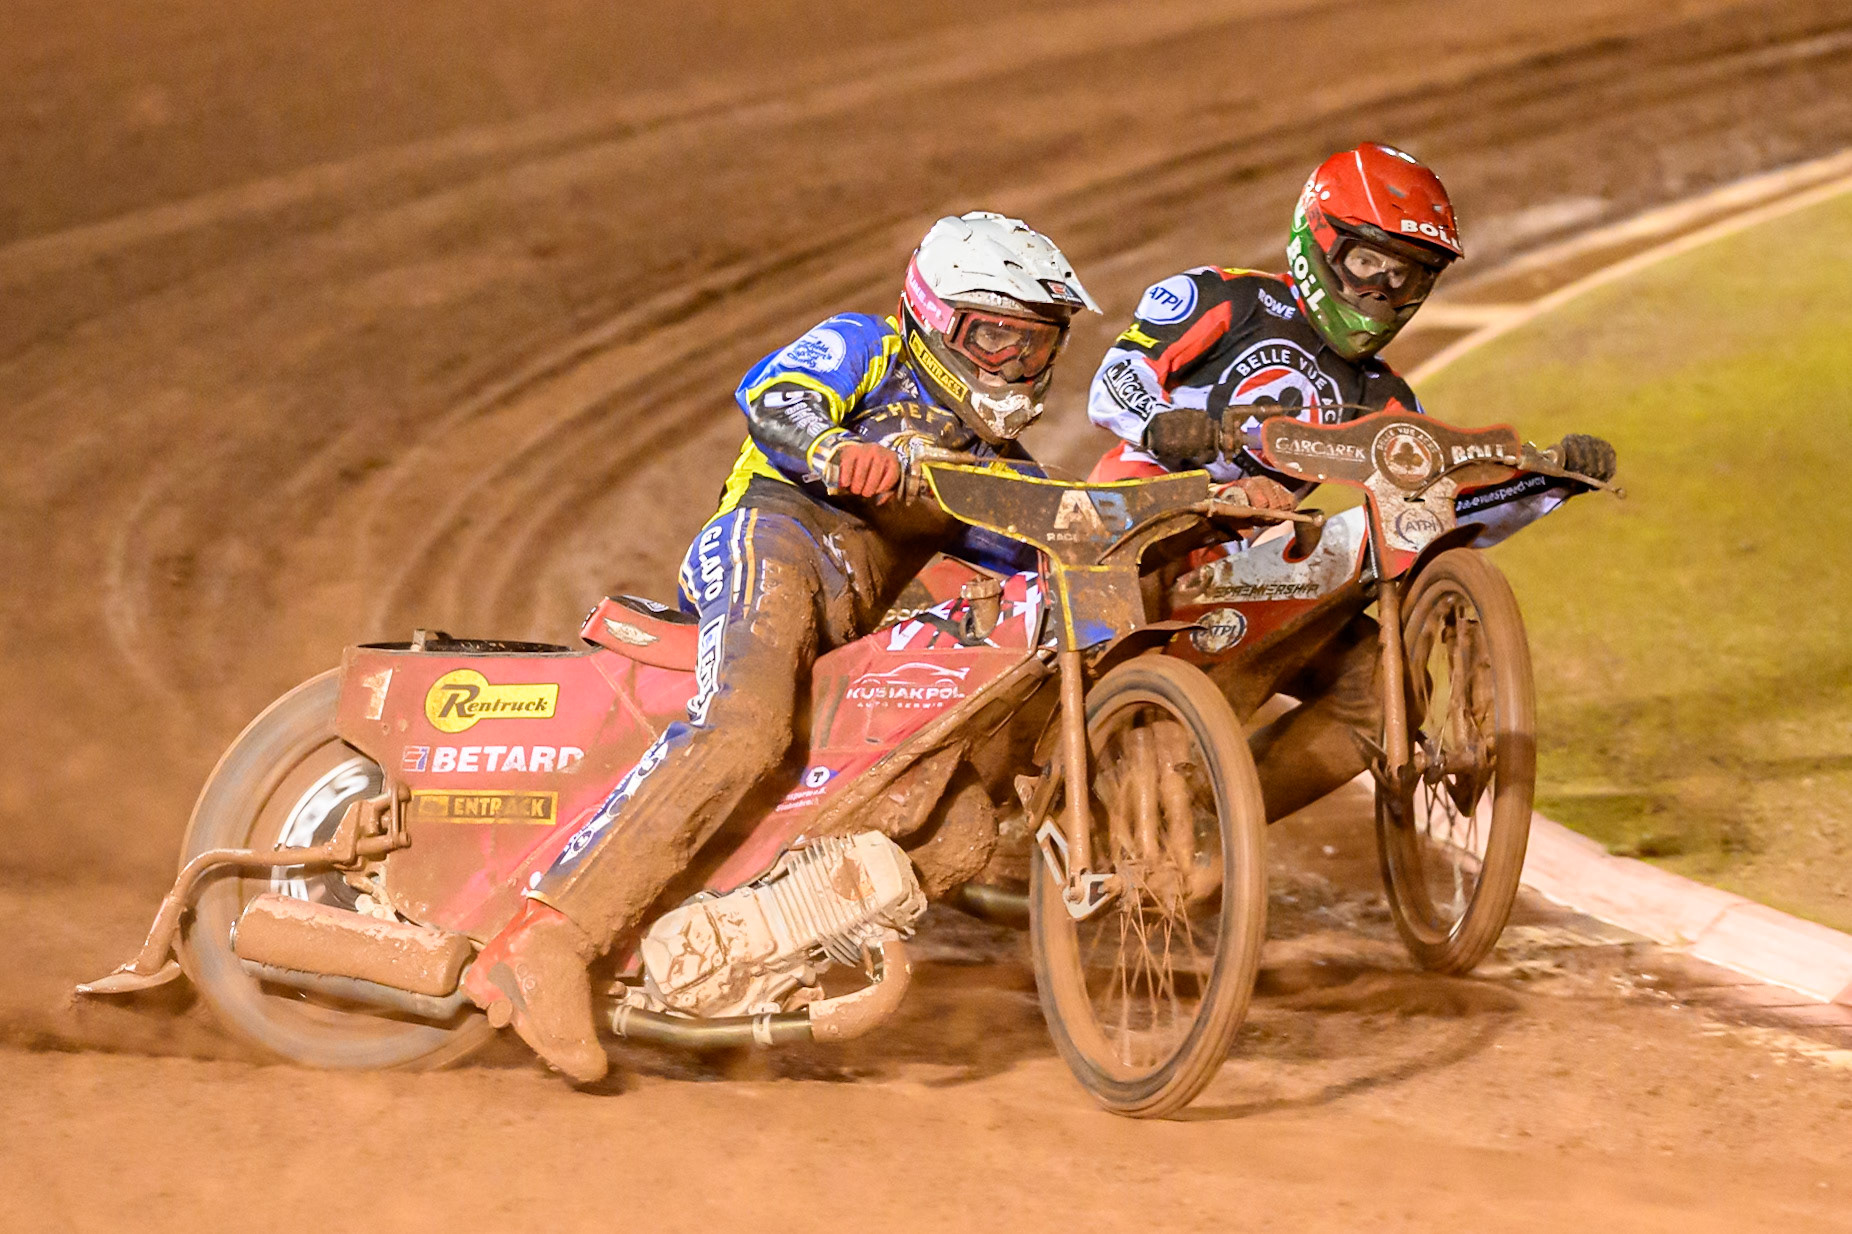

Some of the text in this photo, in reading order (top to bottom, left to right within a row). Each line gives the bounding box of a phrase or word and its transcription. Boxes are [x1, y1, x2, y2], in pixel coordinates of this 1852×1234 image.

[1149, 287, 1184, 312] ATPI
[1258, 288, 1296, 319] ROWE
[1236, 349, 1291, 377] BELLE
[1299, 357, 1327, 391] VUE
[1275, 437, 1366, 460] GARCAREK
[1405, 519, 1437, 533] ATPI
[438, 684, 548, 718] Rentruck
[431, 746, 585, 773] BETARD
[454, 797, 545, 817] ENTRK
